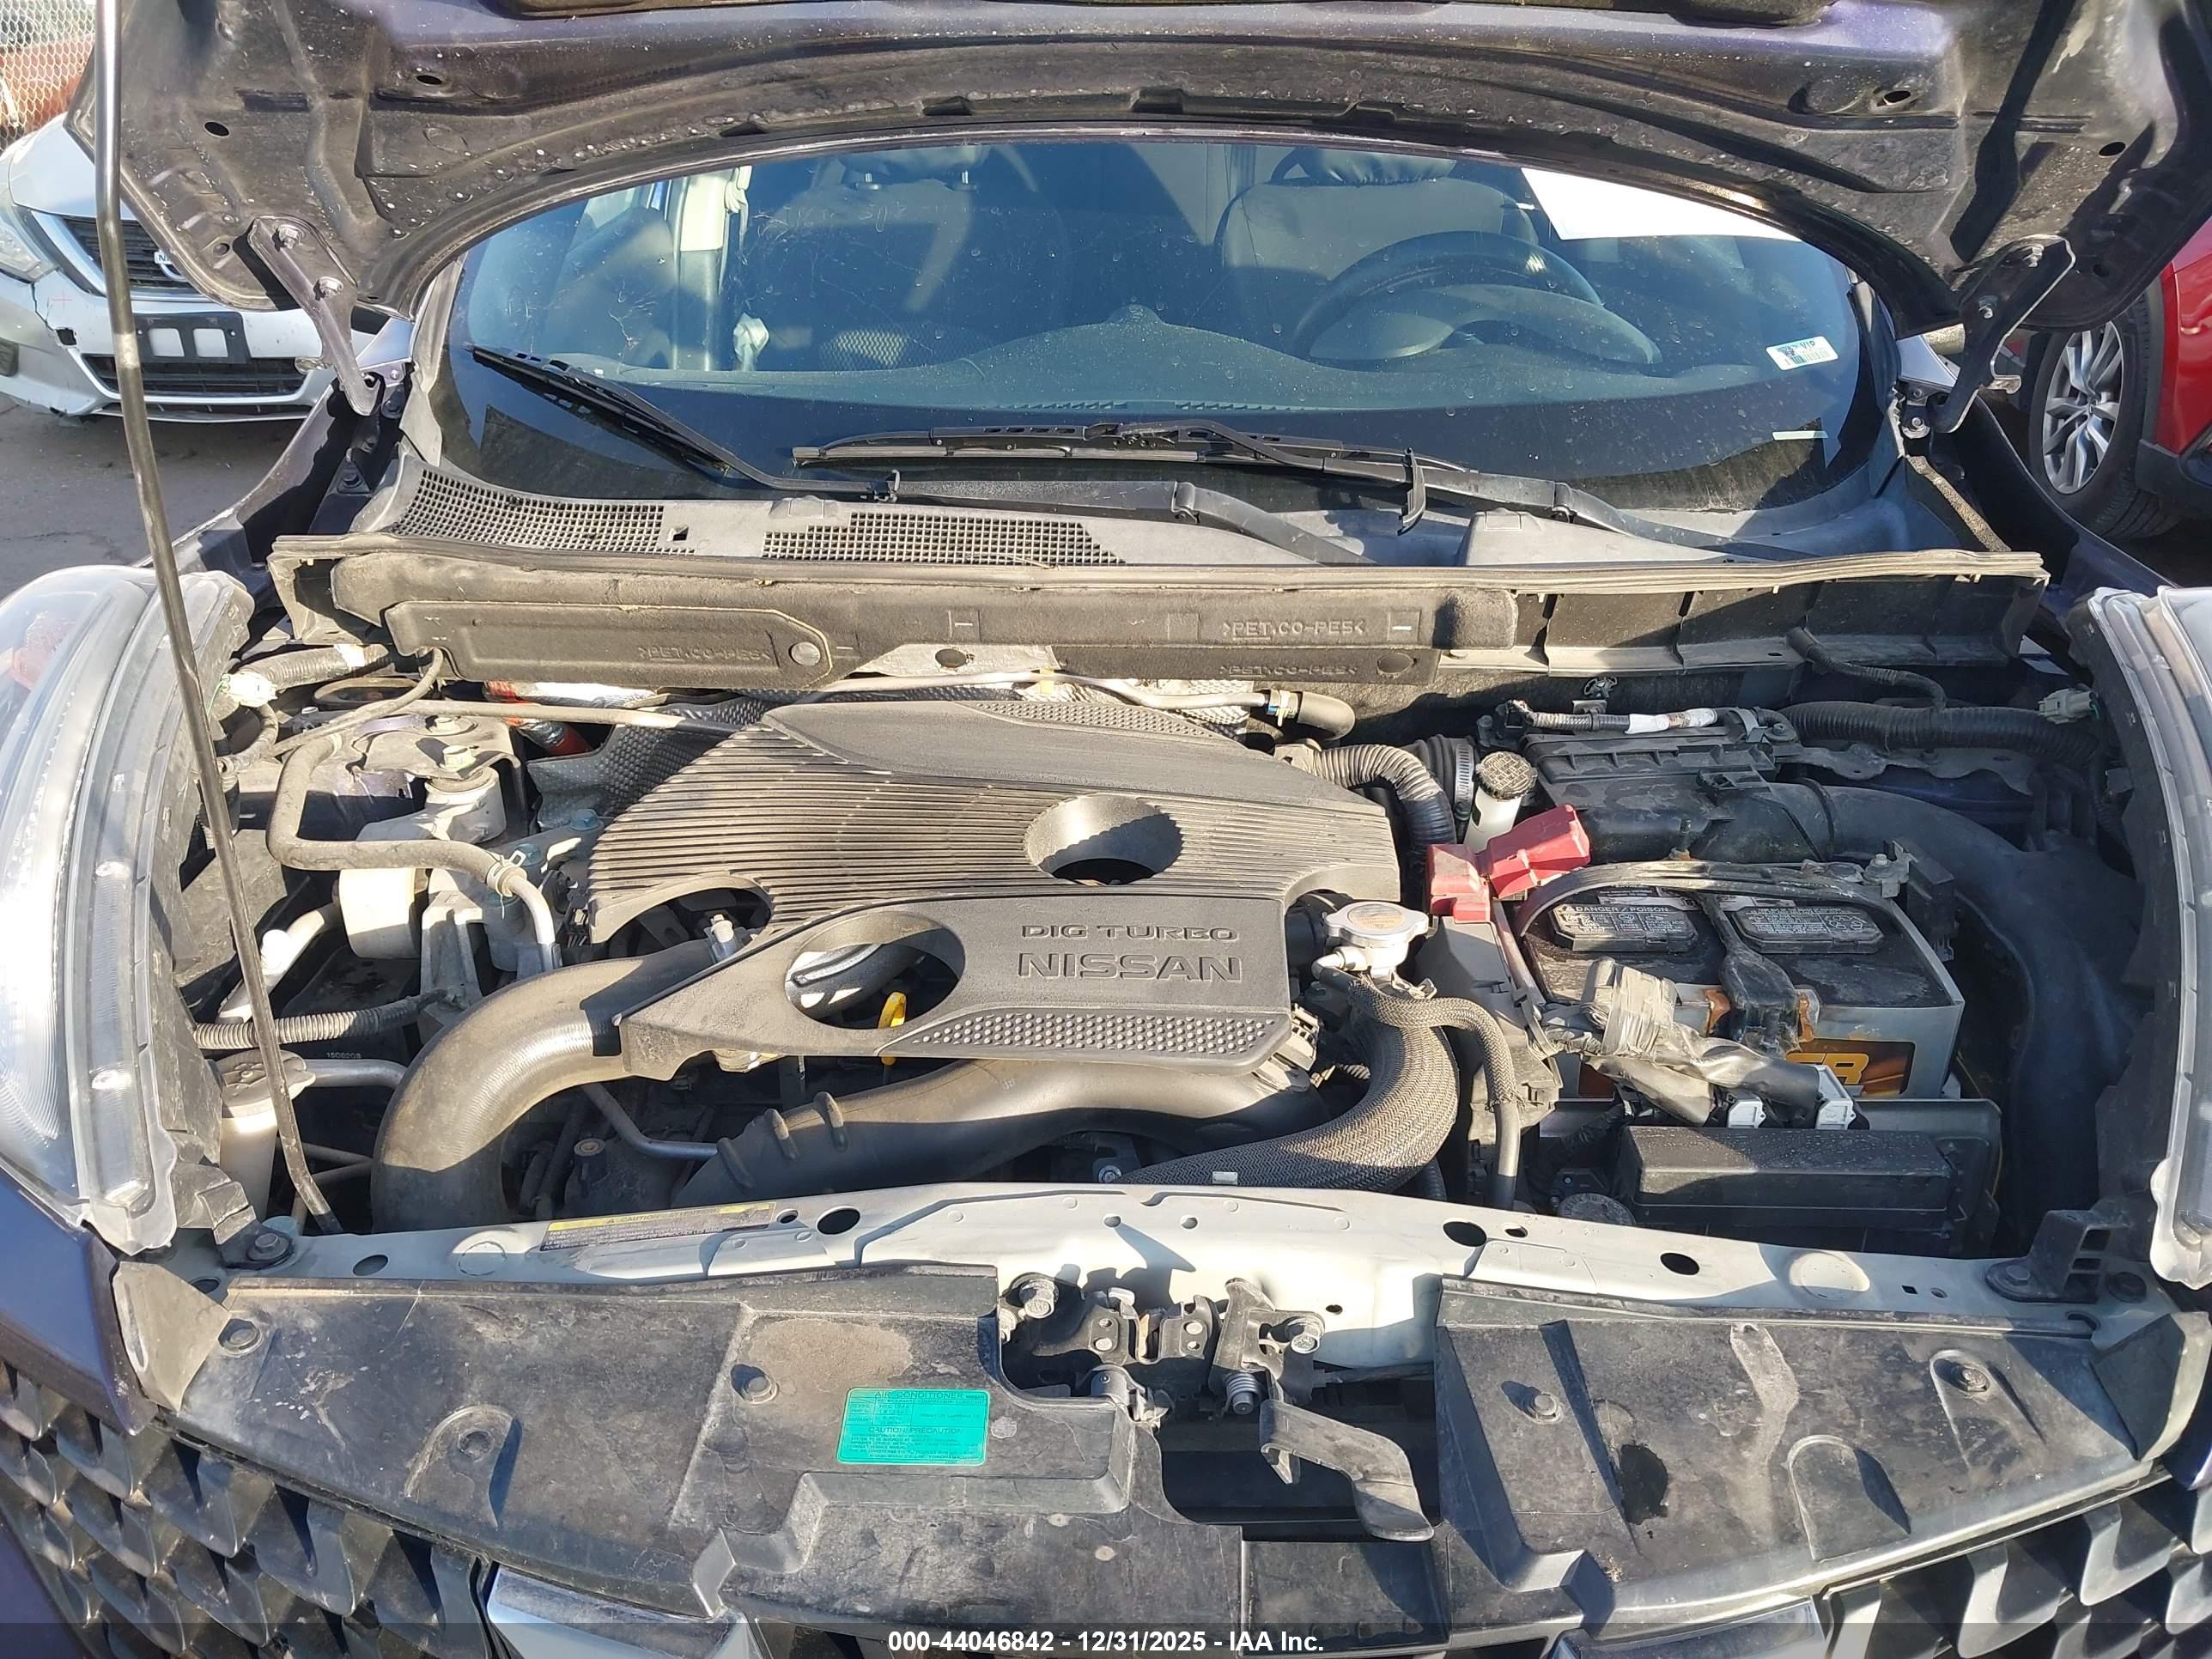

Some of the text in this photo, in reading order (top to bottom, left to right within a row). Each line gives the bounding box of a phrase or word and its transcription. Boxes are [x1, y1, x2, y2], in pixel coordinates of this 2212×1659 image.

[1022, 924, 1239, 942] DIG TURBO
[1018, 952, 1243, 982] NISSAN
